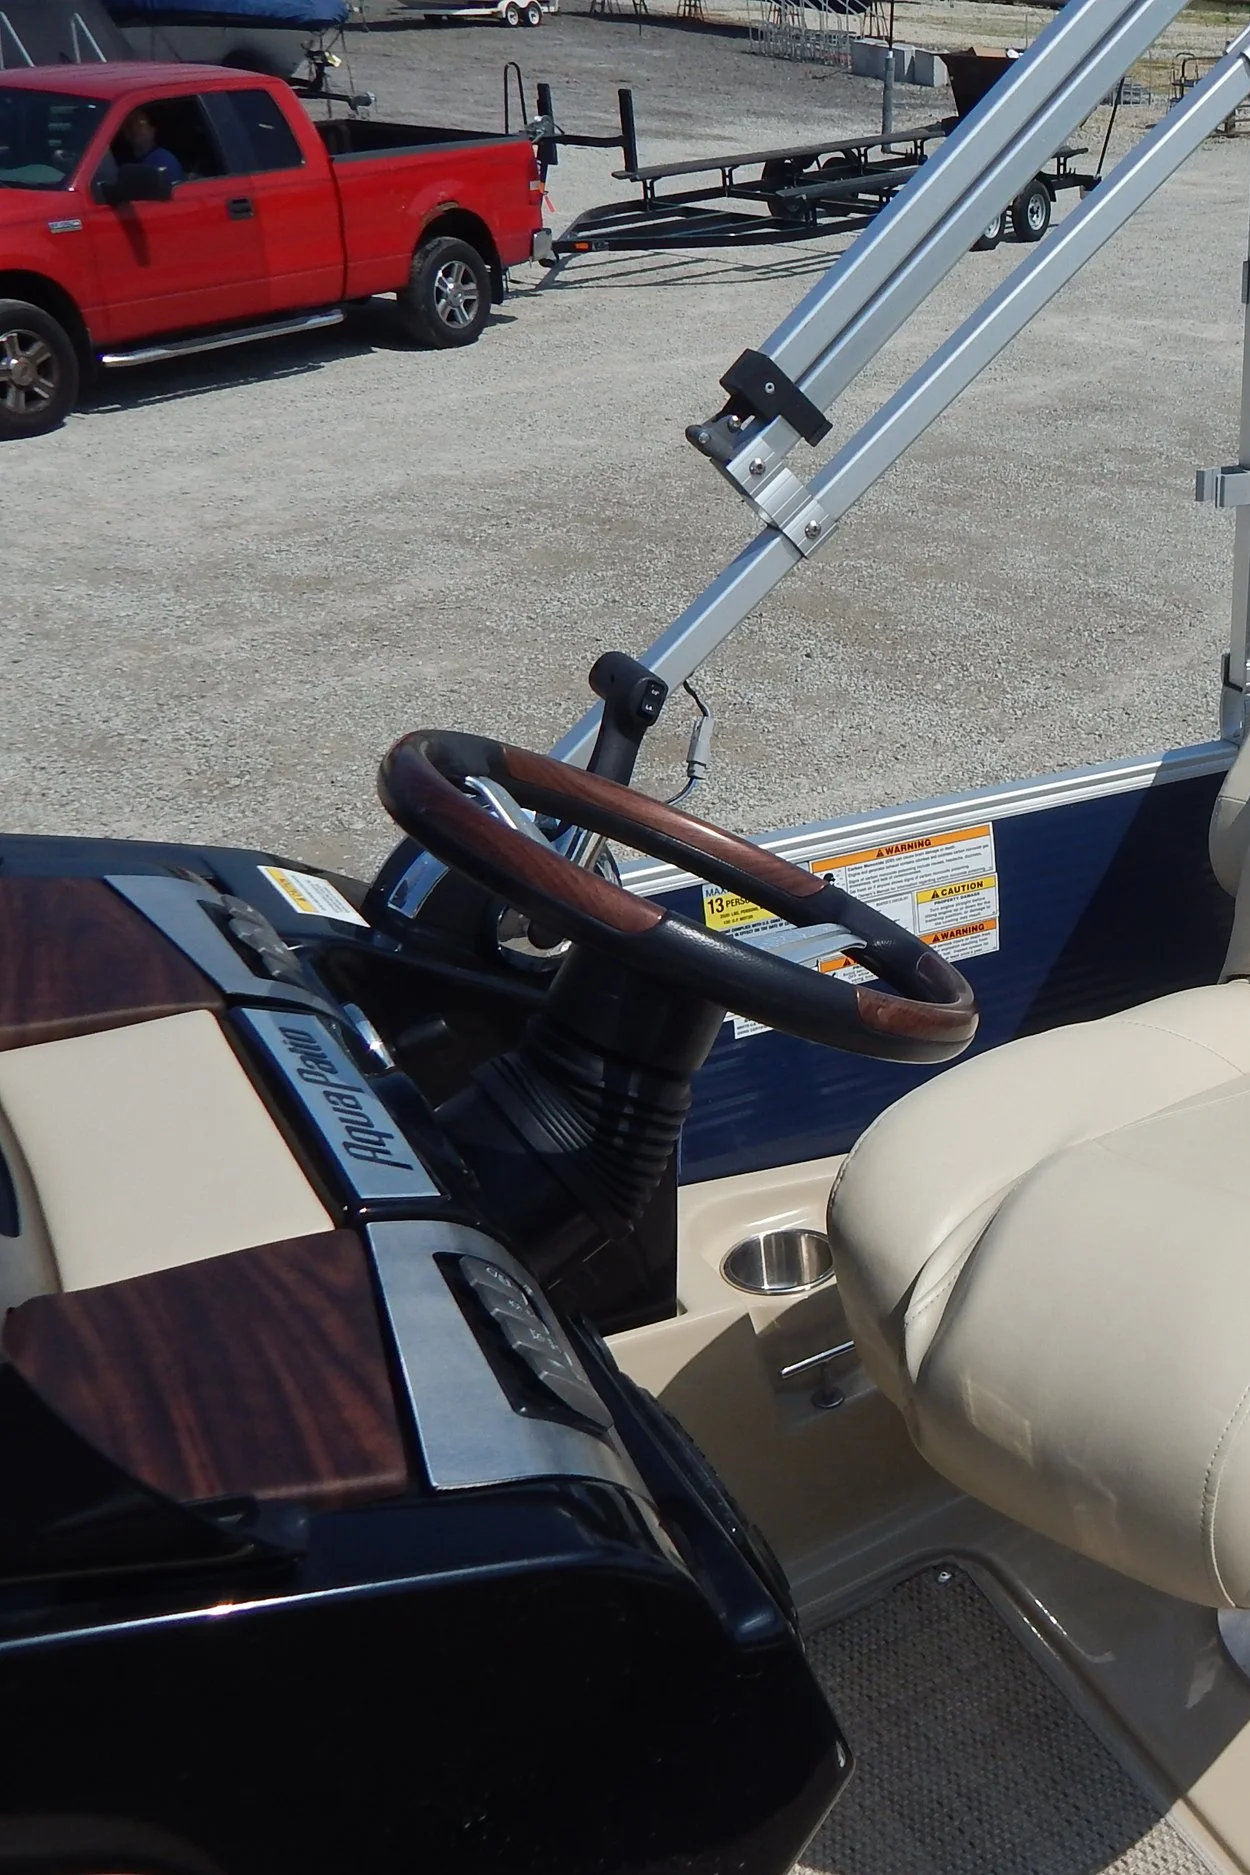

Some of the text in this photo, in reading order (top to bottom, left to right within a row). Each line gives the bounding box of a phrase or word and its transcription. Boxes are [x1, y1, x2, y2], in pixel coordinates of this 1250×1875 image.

[884, 838, 932, 855] WARNING
[940, 881, 984, 896] CAUTION
[707, 897, 725, 914] 13
[940, 923, 985, 940] WARNING
[278, 1026, 414, 1171] Aqua Patio
